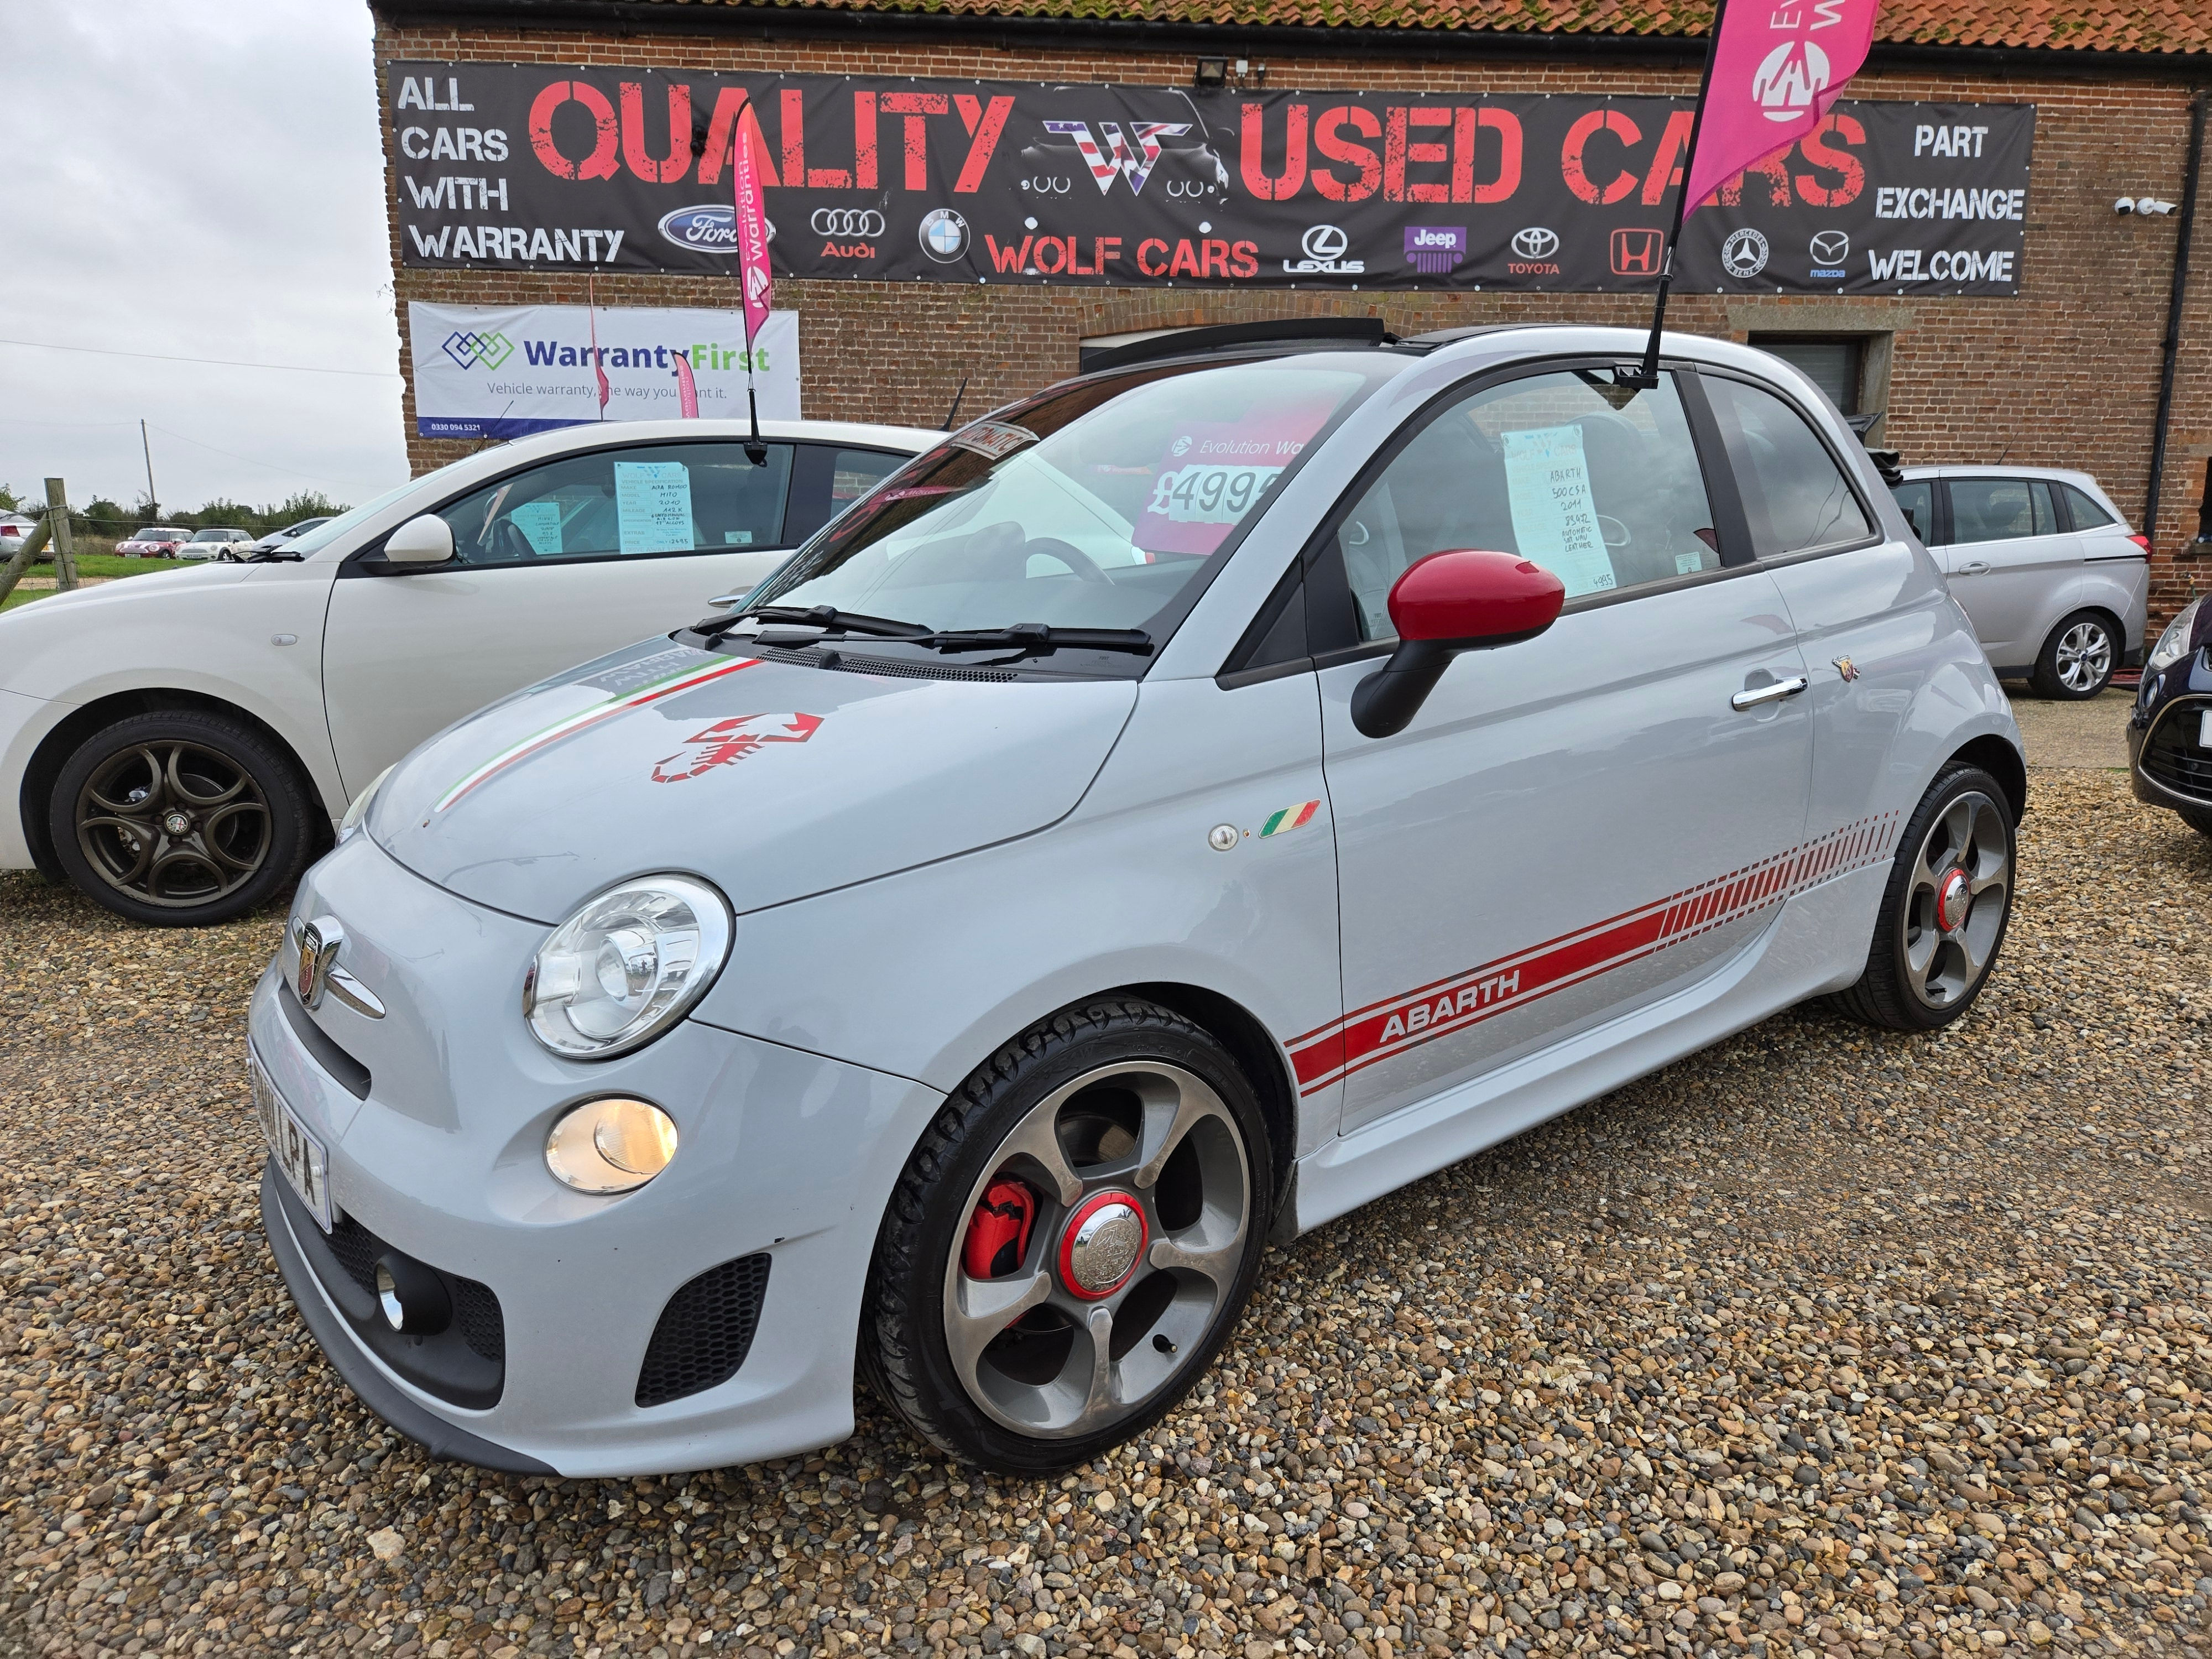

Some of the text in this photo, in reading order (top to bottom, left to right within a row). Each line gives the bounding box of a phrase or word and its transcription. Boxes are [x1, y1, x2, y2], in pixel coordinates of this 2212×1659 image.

[398, 77, 474, 111] ALL
[401, 127, 509, 162] CARS
[529, 80, 1016, 193] QUALITY
[1240, 103, 1524, 204] USED
[1914, 125, 1988, 158] PART
[404, 175, 508, 211] WITH
[1876, 187, 2025, 221] EXCHANGE
[925, 211, 965, 228] BMW
[686, 215, 739, 242] For
[1730, 230, 1764, 243] MERCEDES
[408, 225, 625, 262] WARRANTY
[1414, 229, 1456, 248] Jeep
[821, 242, 875, 259] Audi
[984, 234, 1259, 278] WOLF CARS
[1283, 260, 1365, 274] LEXUS
[1507, 263, 1560, 275] TOYOTA
[1810, 269, 1846, 278] mazda
[1868, 249, 2015, 281] WELCOME
[487, 383, 533, 394] Vehicle
[536, 384, 597, 399] warranty,
[623, 387, 648, 399] way
[651, 388, 676, 400] you
[716, 388, 728, 399] it.
[1200, 440, 1270, 455] Evolution
[1550, 467, 1581, 483] ABARTH
[1561, 499, 1582, 511] 2011
[1562, 526, 1593, 538] AUTOMATIC
[1565, 541, 1594, 552] LEATHER
[1593, 573, 1613, 588] 4995
[1379, 969, 1520, 1043] ABARTH
